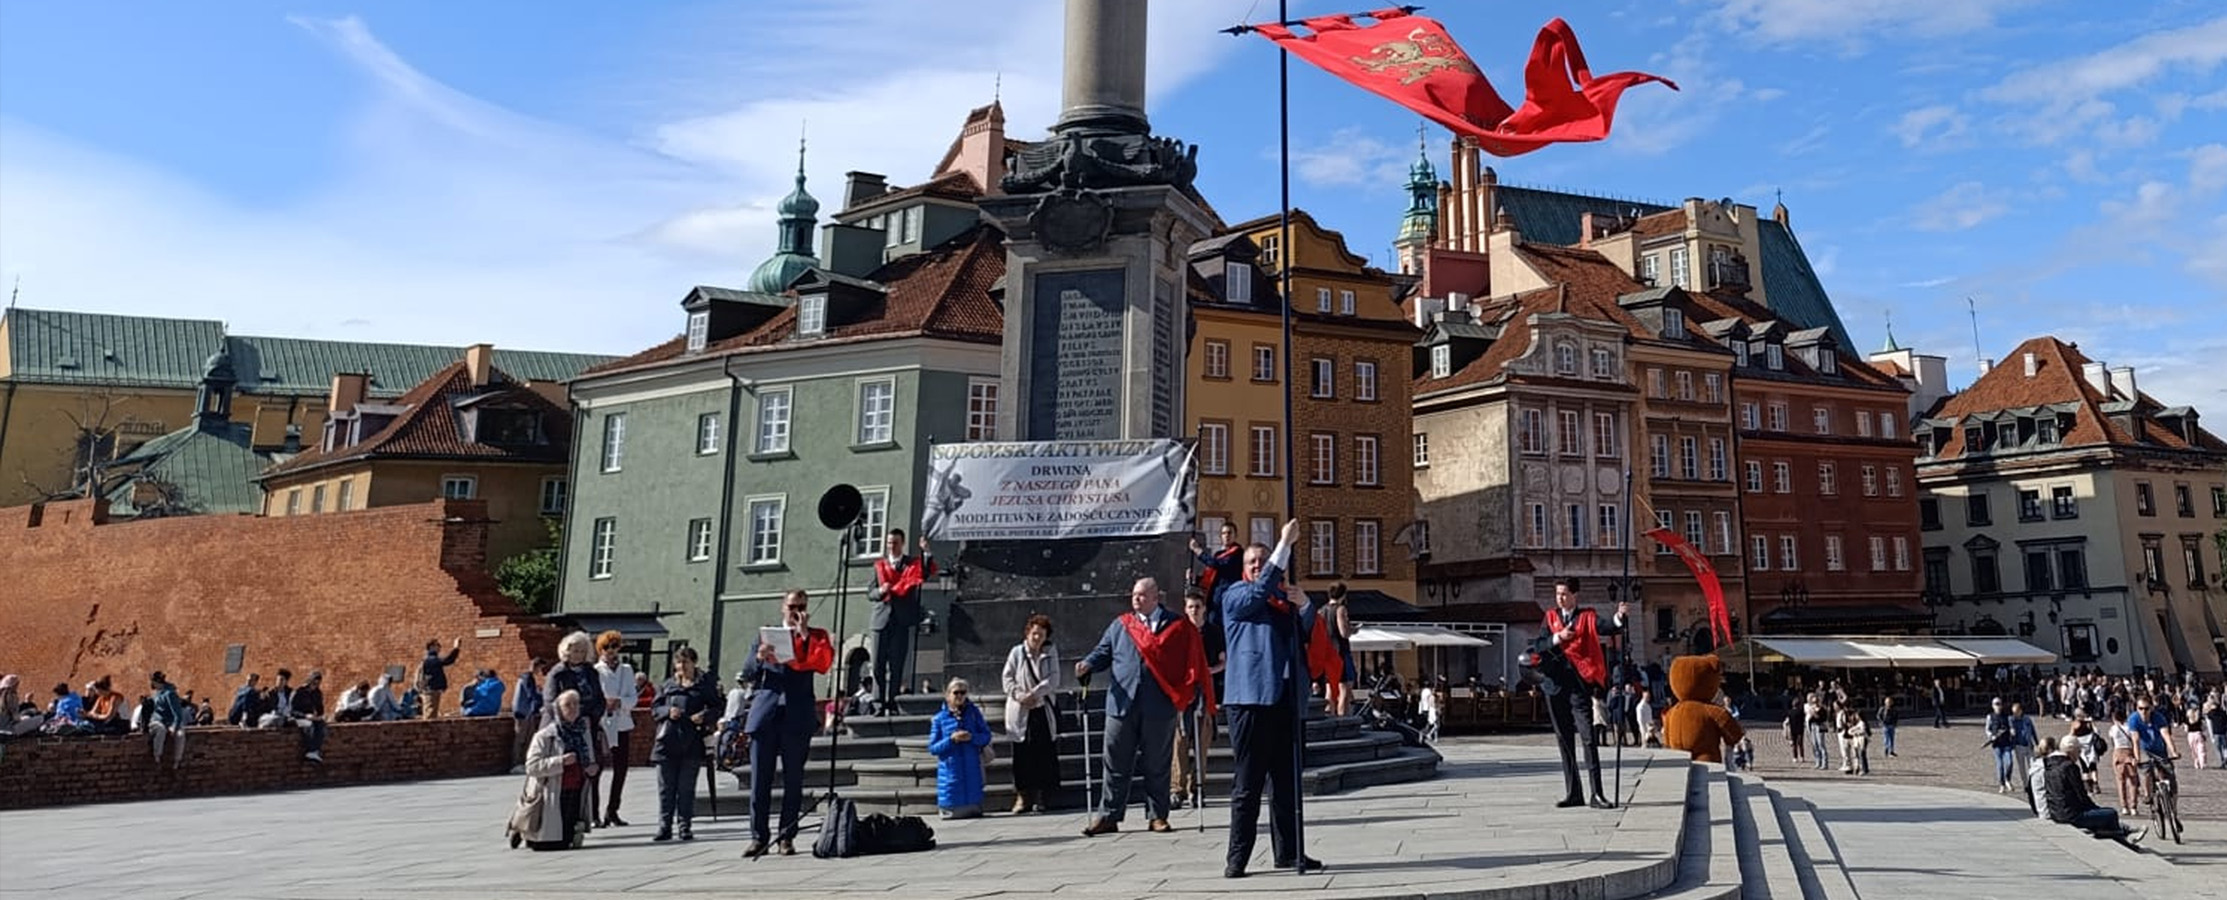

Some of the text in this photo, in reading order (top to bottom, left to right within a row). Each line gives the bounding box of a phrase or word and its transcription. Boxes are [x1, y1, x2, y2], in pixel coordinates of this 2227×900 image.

[1001, 478, 1120, 491] Z NASZEGO PANA
[989, 492, 1130, 506] JEZUSA CHRYSTUSA
[955, 507, 1171, 524] MODLITEWNE ZADOŚĆUCZYNIEN
